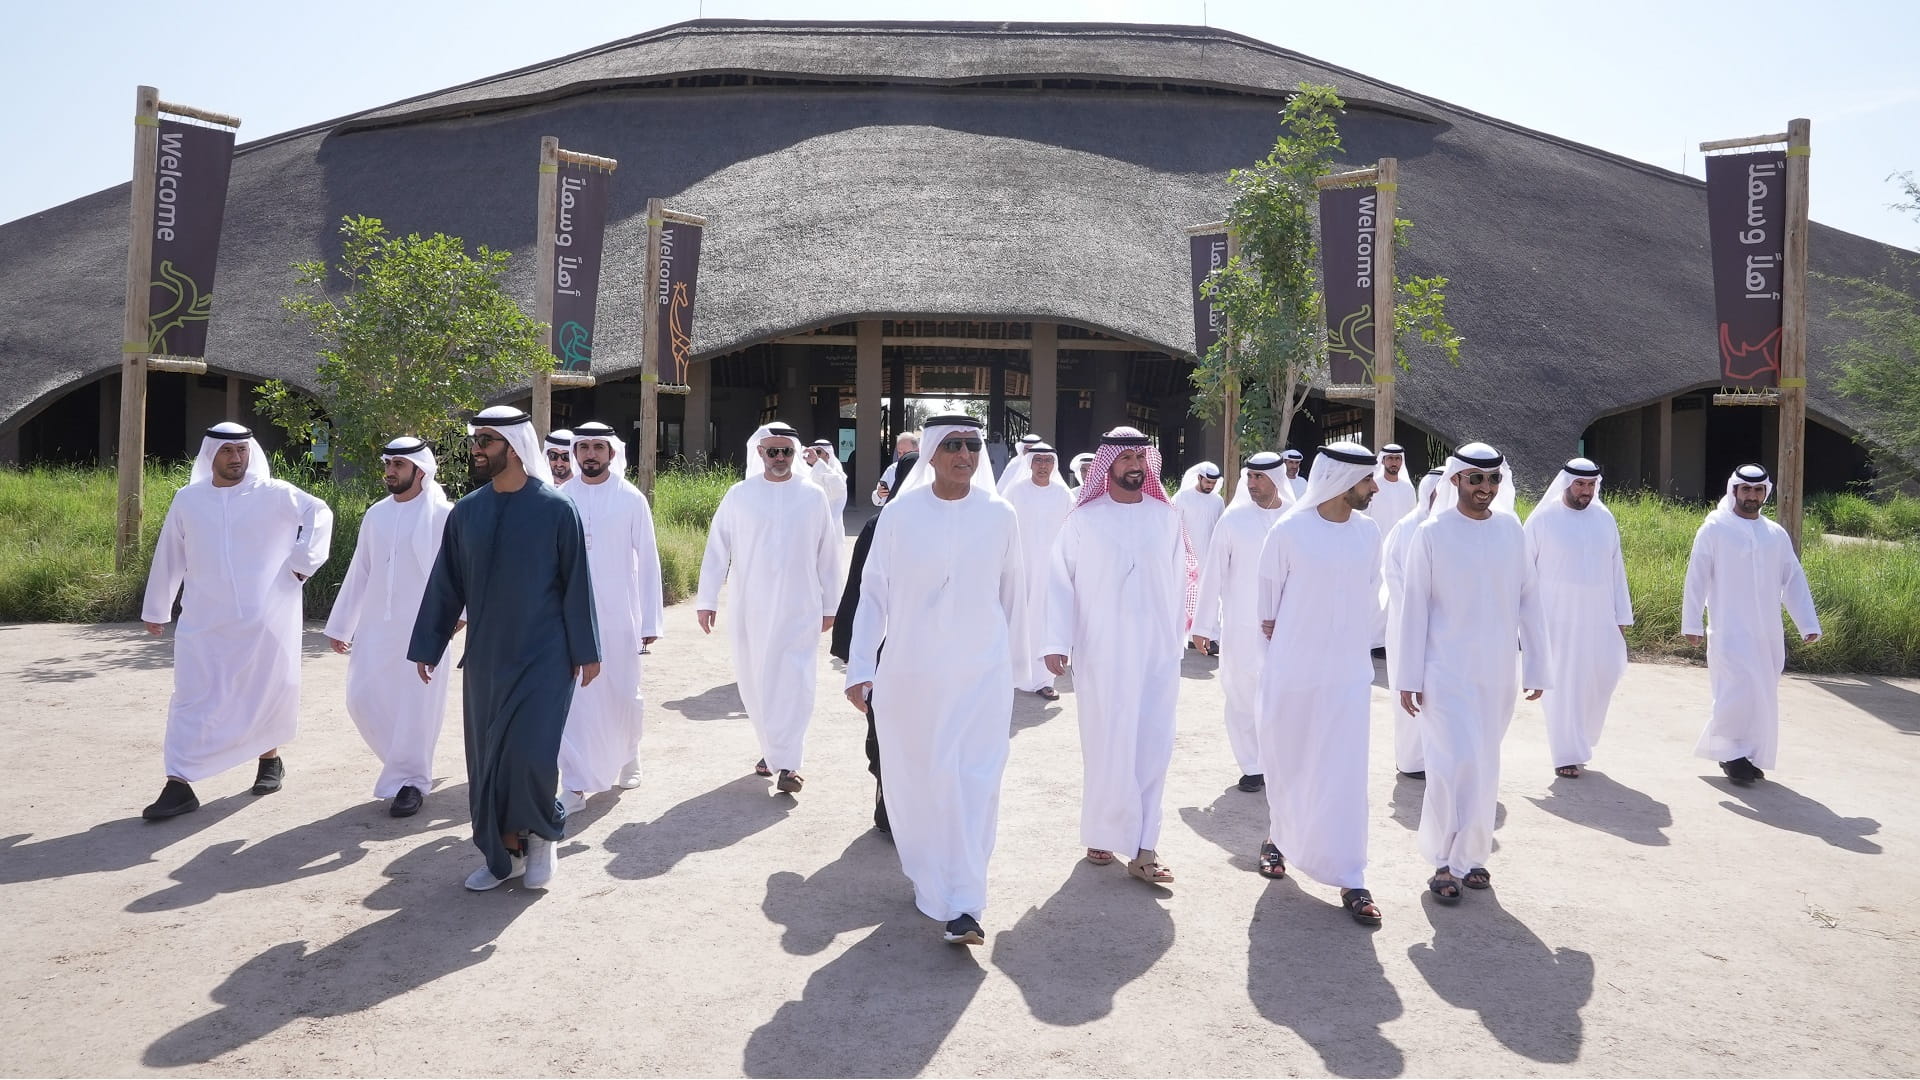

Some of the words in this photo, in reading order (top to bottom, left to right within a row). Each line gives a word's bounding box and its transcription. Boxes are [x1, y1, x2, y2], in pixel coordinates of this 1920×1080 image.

[157, 133, 183, 242] Welcome
[1739, 161, 1785, 245] وسهلاً
[659, 228, 674, 305] Welcome
[1358, 195, 1376, 288] Welcome
[1745, 252, 1783, 300] أهلاً
